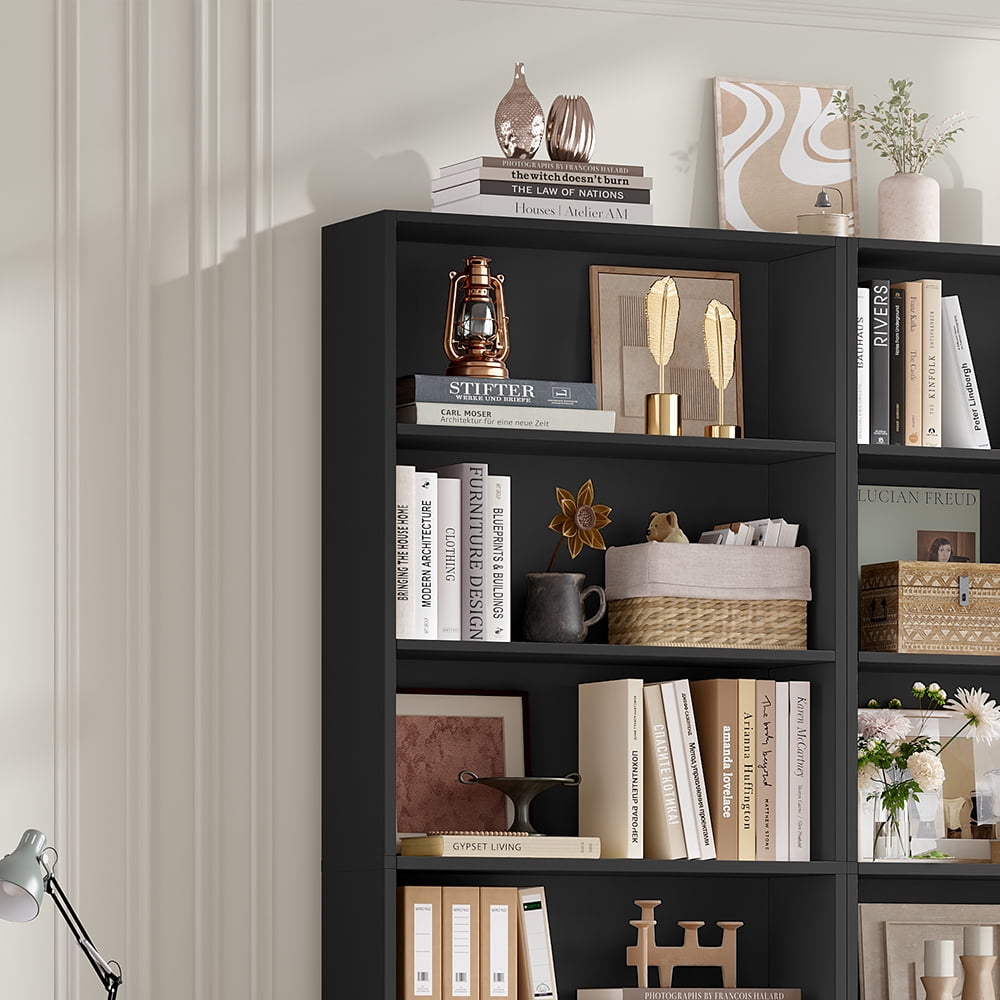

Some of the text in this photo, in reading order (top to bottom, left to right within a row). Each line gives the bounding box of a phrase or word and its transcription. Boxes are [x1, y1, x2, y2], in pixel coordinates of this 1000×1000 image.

[512, 185, 624, 199] THE LAW OF NATIONS
[873, 285, 888, 347] RIVERS
[450, 382, 535, 398] STIFTER
[962, 362, 981, 431] Peter Lindbergh
[858, 489, 976, 506] LUCIAN FREUD
[397, 504, 408, 601] BRINGING THE HOUSE HOME
[422, 500, 431, 607] MODERN ARCHITECTURE
[446, 527, 455, 581] CLOTHING
[469, 466, 483, 640] FURNITURE DESIGN
[493, 508, 503, 562] BLUEPRINTS
[493, 573, 503, 619] BUILDINGS
[797, 696, 806, 724] Karen
[653, 724, 679, 825] СПАСИТЕ КОТИКА!
[723, 726, 733, 818] amanda lovelace
[741, 712, 753, 830] Arianna Huffington
[794, 726, 807, 778] McCartney
[491, 843, 522, 851] LIVING
